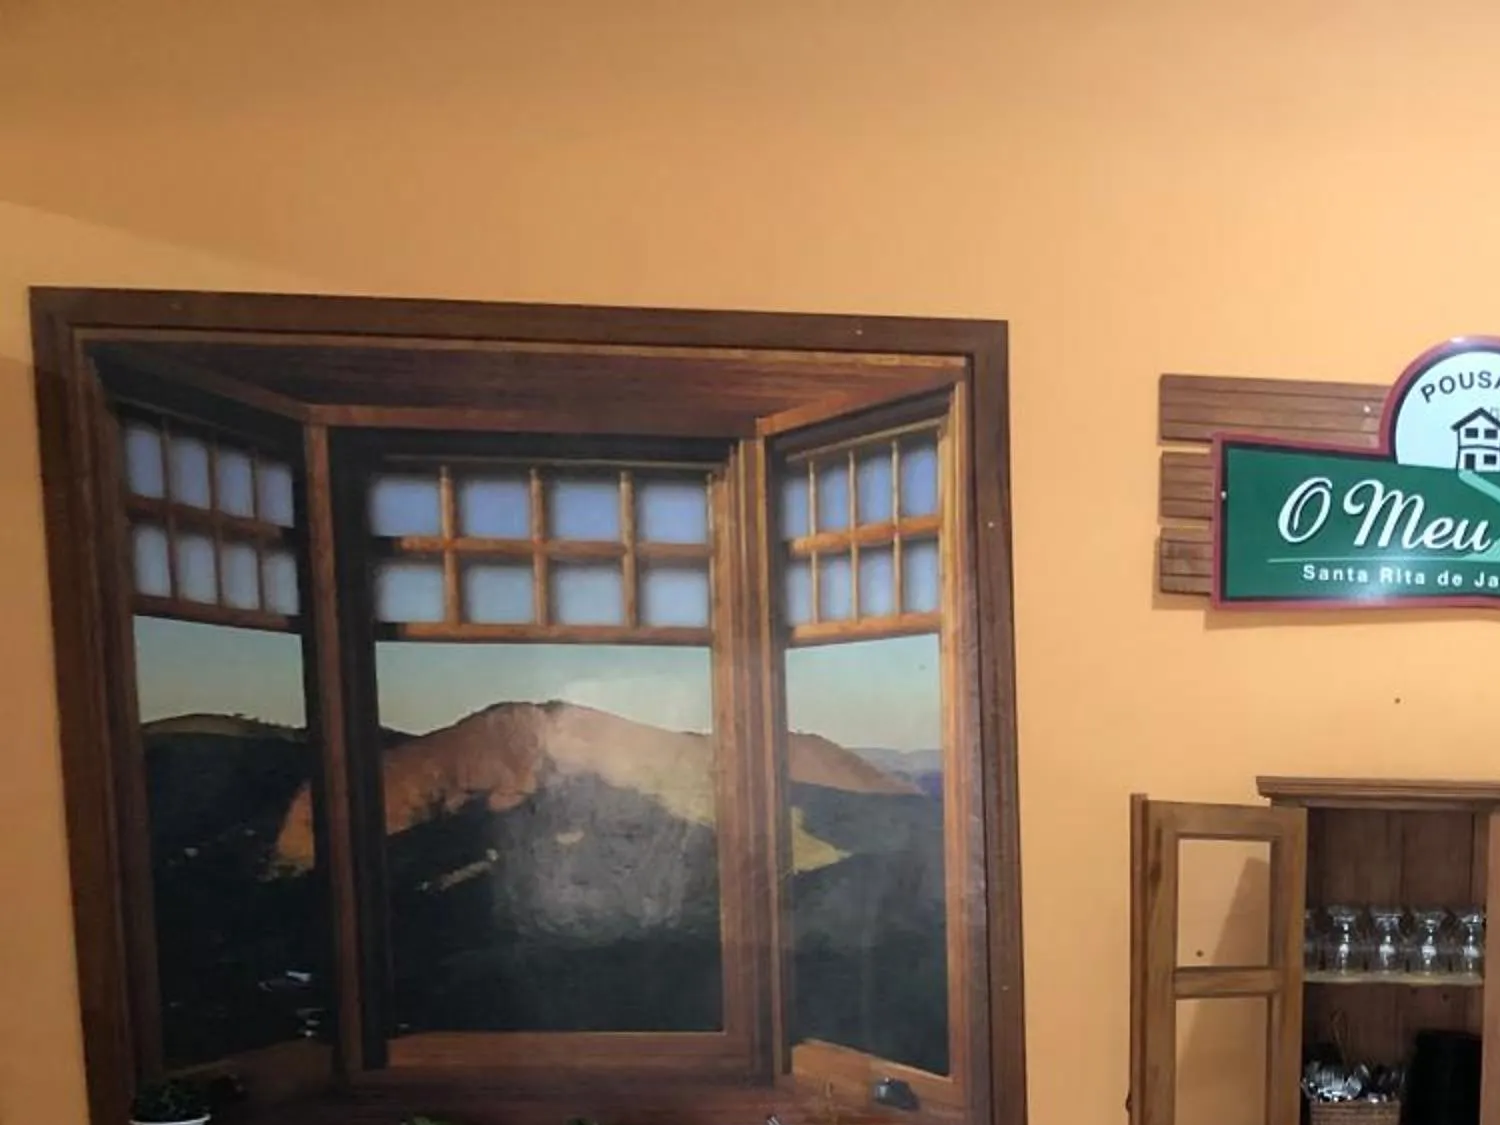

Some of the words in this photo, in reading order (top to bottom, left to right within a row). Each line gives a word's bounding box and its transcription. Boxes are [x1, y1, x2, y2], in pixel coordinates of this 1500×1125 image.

[1278, 477, 1333, 543] O
[1343, 479, 1491, 550] Meu
[1303, 564, 1368, 584] Santa
[1379, 566, 1426, 586] Rita
[1437, 570, 1463, 588] de
